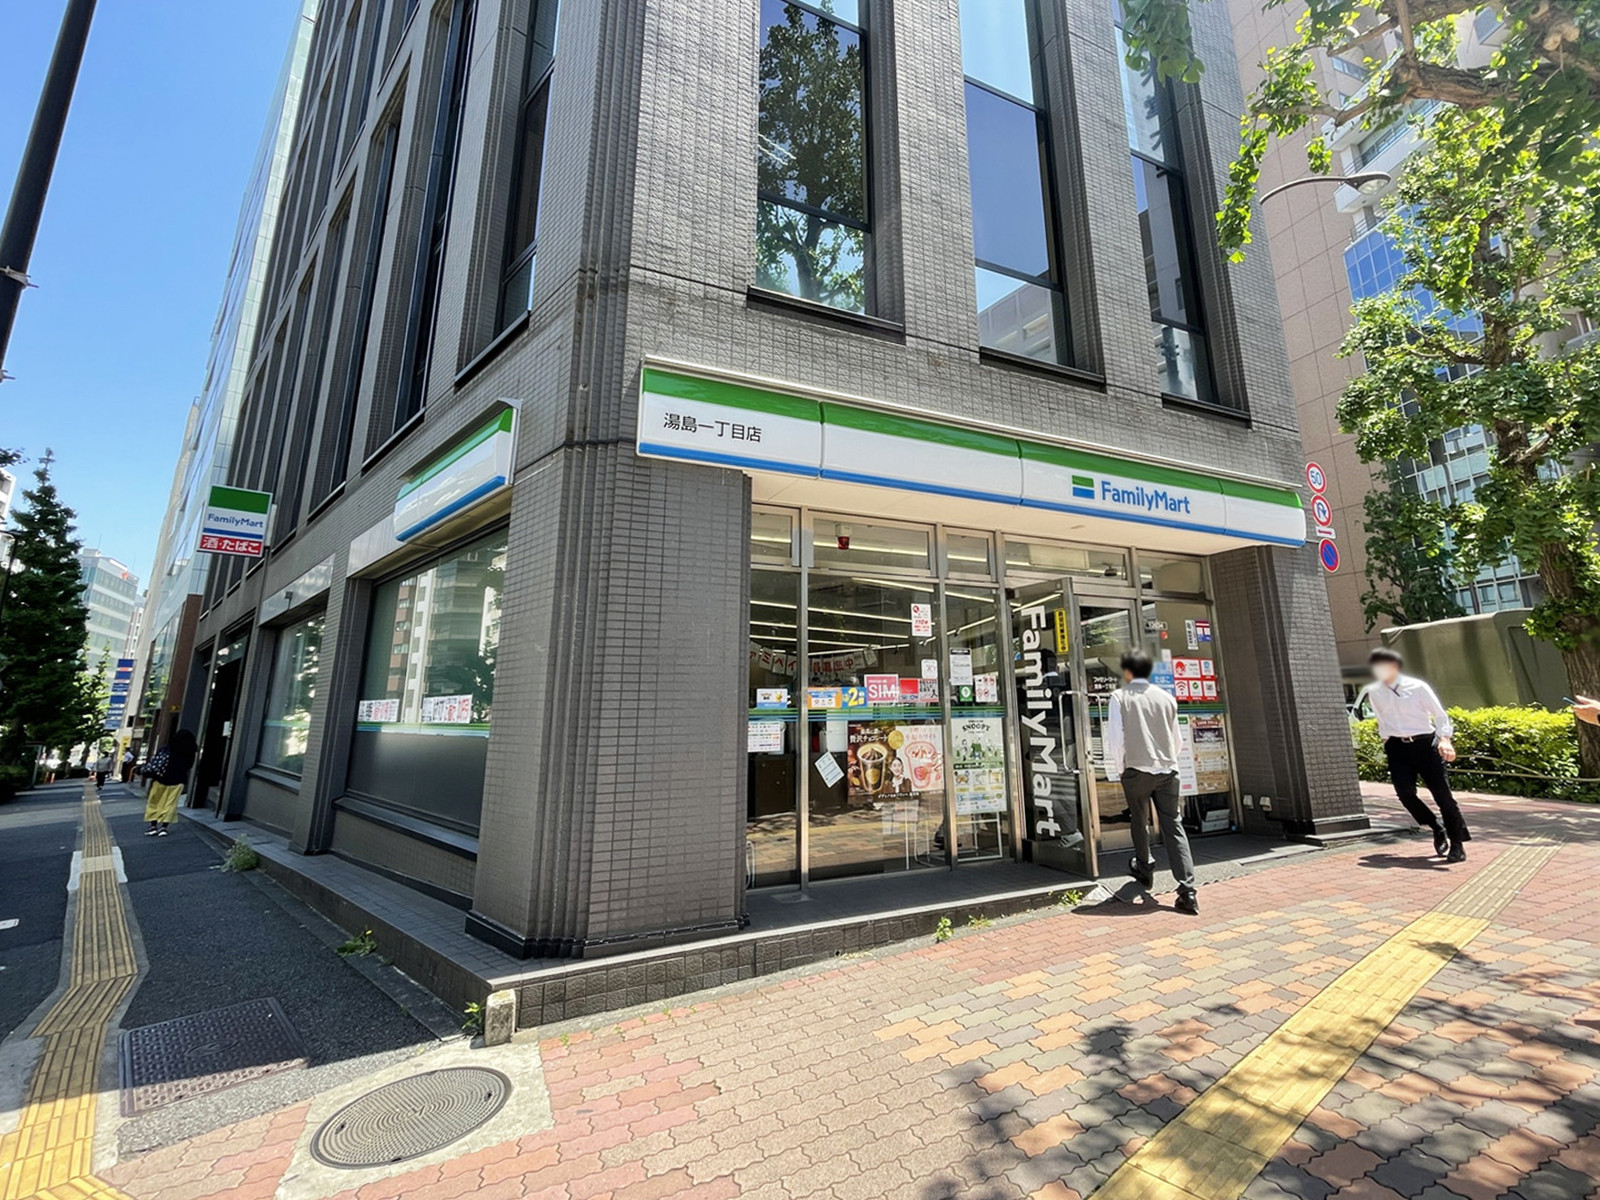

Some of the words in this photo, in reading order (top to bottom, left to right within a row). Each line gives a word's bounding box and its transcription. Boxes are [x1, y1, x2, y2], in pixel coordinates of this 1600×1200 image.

[663, 412, 762, 442] 湯島一丁目店
[1310, 470, 1322, 486] 50
[1101, 480, 1190, 514] FamilyMart
[207, 513, 264, 528] FamilyMart
[962, 723, 991, 732] SNOOPY
[1021, 605, 1062, 837] FamilyMart
